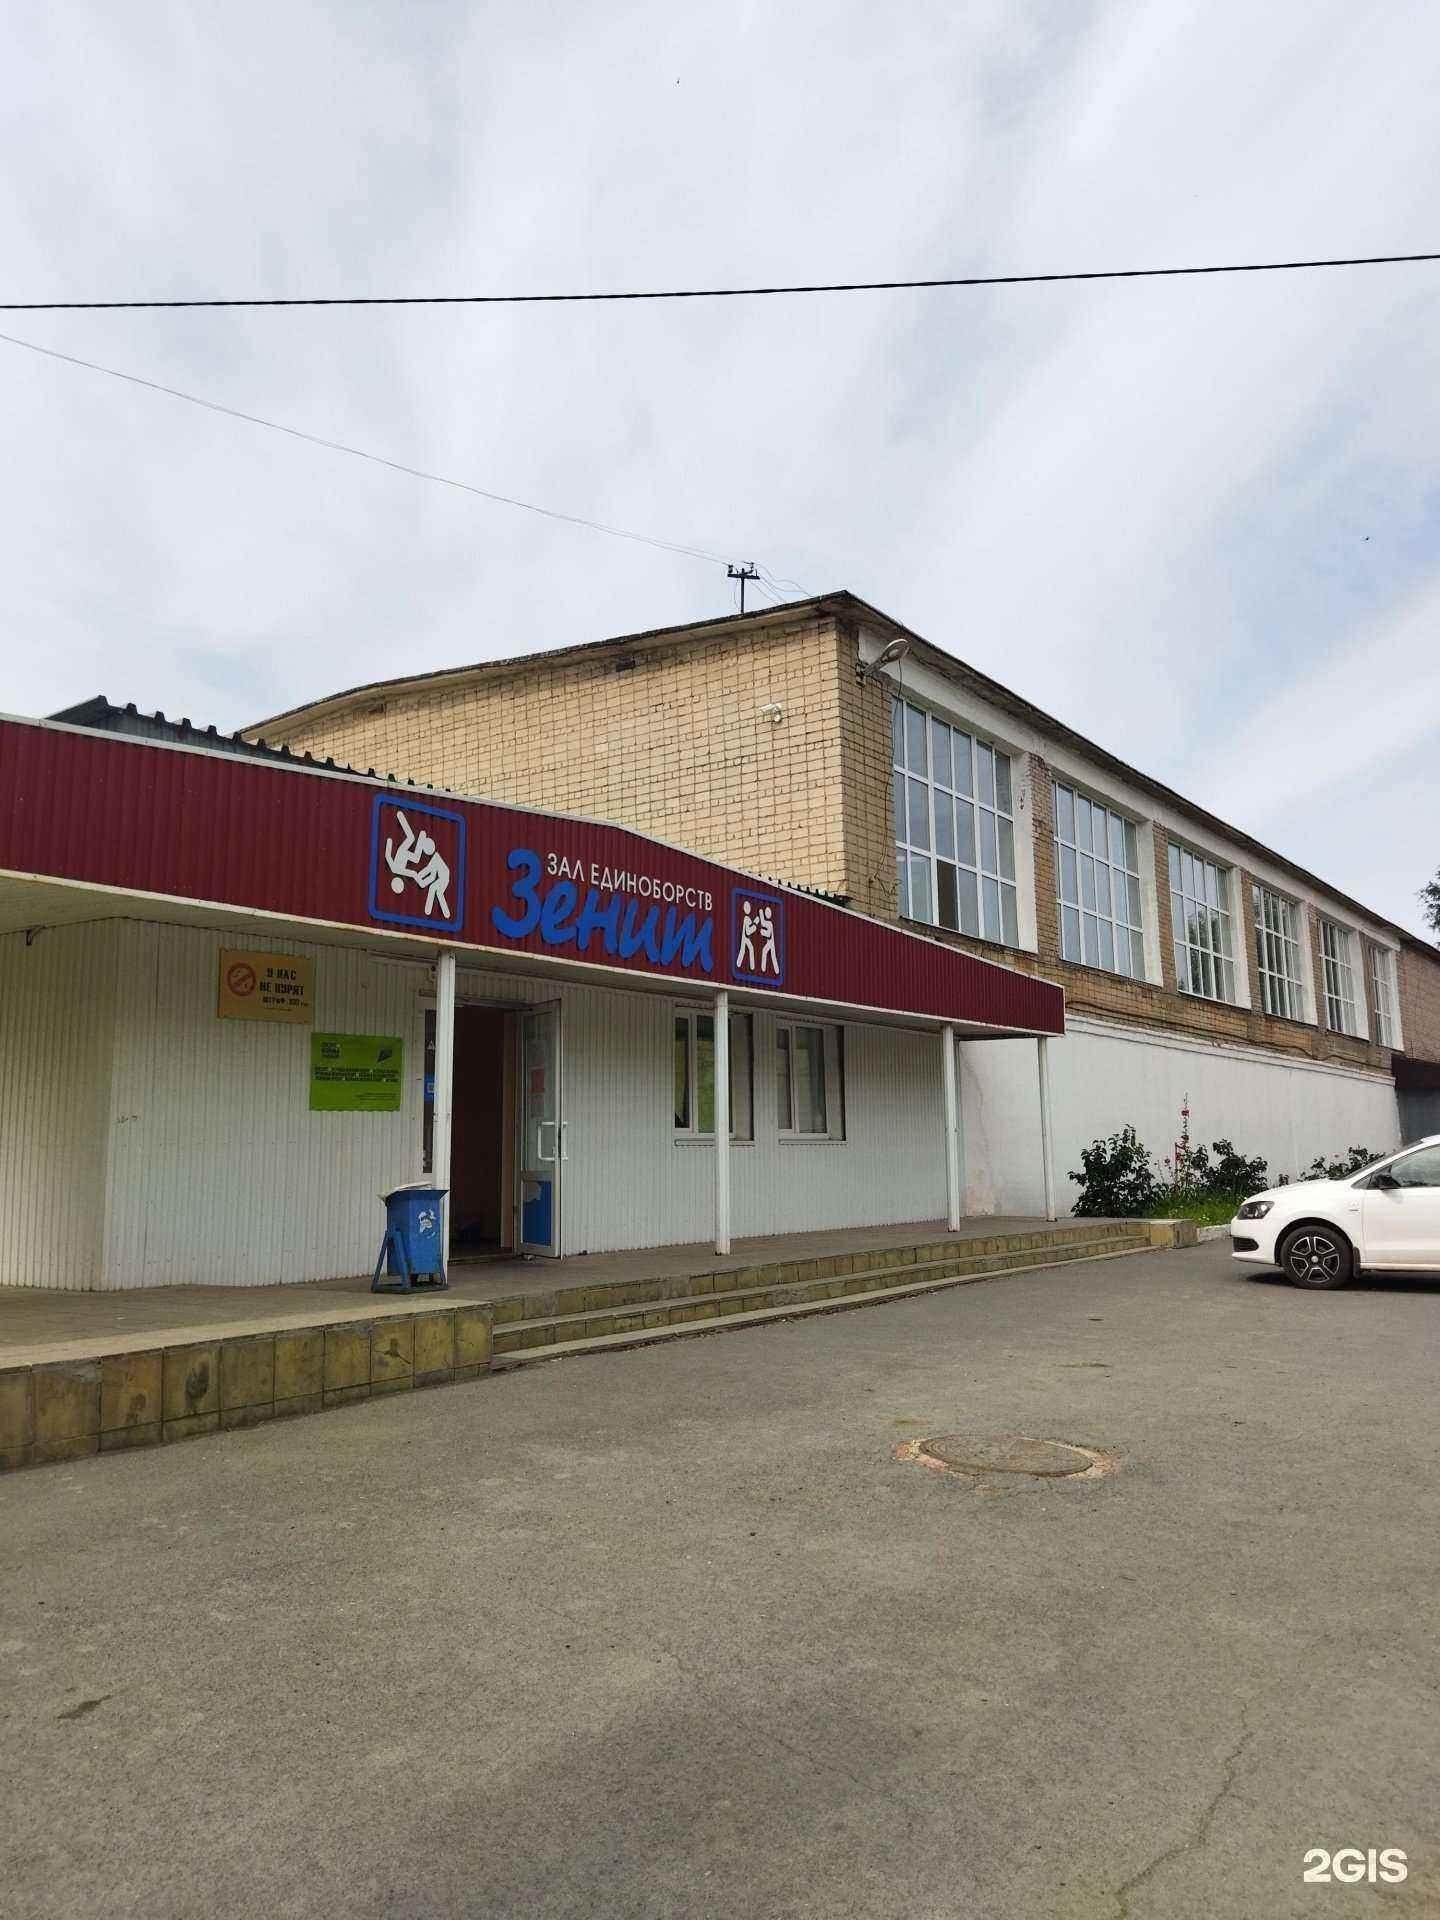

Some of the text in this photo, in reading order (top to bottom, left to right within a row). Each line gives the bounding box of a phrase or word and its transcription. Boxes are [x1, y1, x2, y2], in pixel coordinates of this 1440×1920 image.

[491, 848, 714, 974] Зенит
[547, 853, 713, 911] ЗАЛ ЕДИНОБОРСТВ
